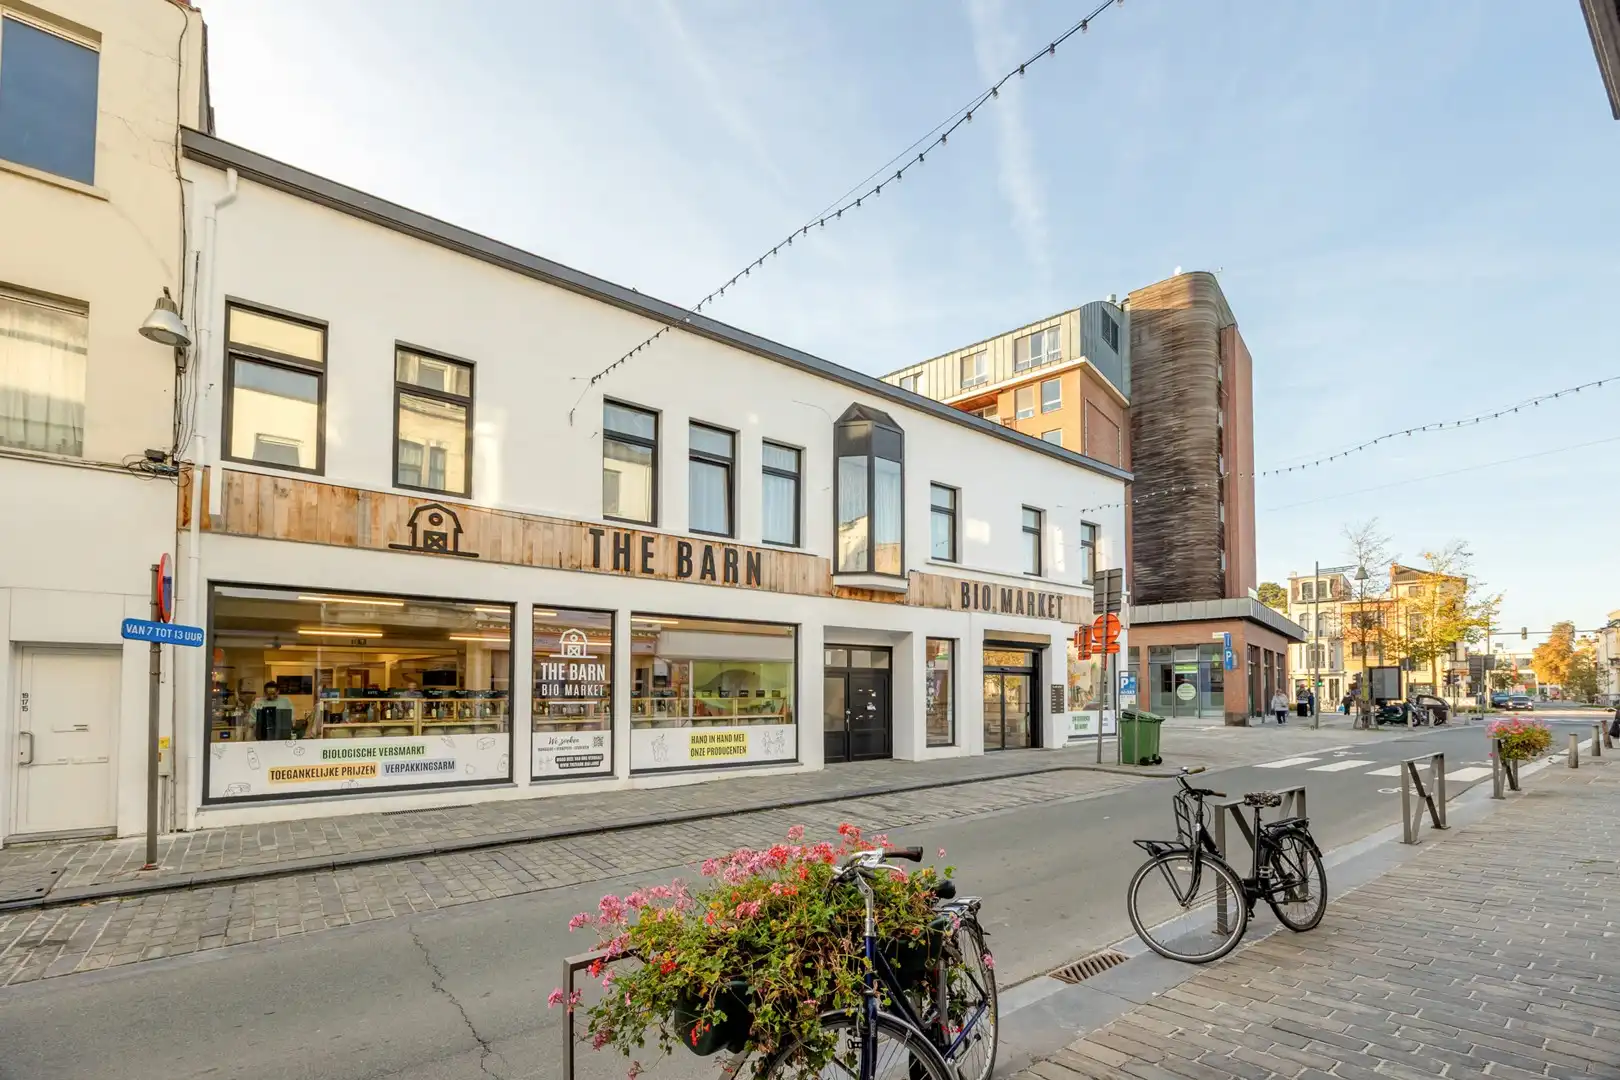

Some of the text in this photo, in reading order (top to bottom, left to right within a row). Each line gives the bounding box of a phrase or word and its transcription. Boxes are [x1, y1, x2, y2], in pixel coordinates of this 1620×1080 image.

[589, 528, 761, 587] THE BARN
[961, 582, 1063, 619] BIO MARKET
[126, 623, 203, 642] VAN 7 TOT 13 UUR
[541, 662, 606, 681] THE BARN
[541, 683, 604, 697] BIO MARKET
[1121, 677, 1129, 689] P
[691, 733, 745, 745] HAND IN HAND MET
[322, 745, 425, 760] BIOLOGISCHE VERSMARKT
[690, 745, 747, 757] ONZE PRODUCENTEN
[270, 764, 376, 781] TOEGANKELIJKE PRIJZEN
[385, 760, 456, 774] VERPAKKINGSARM
